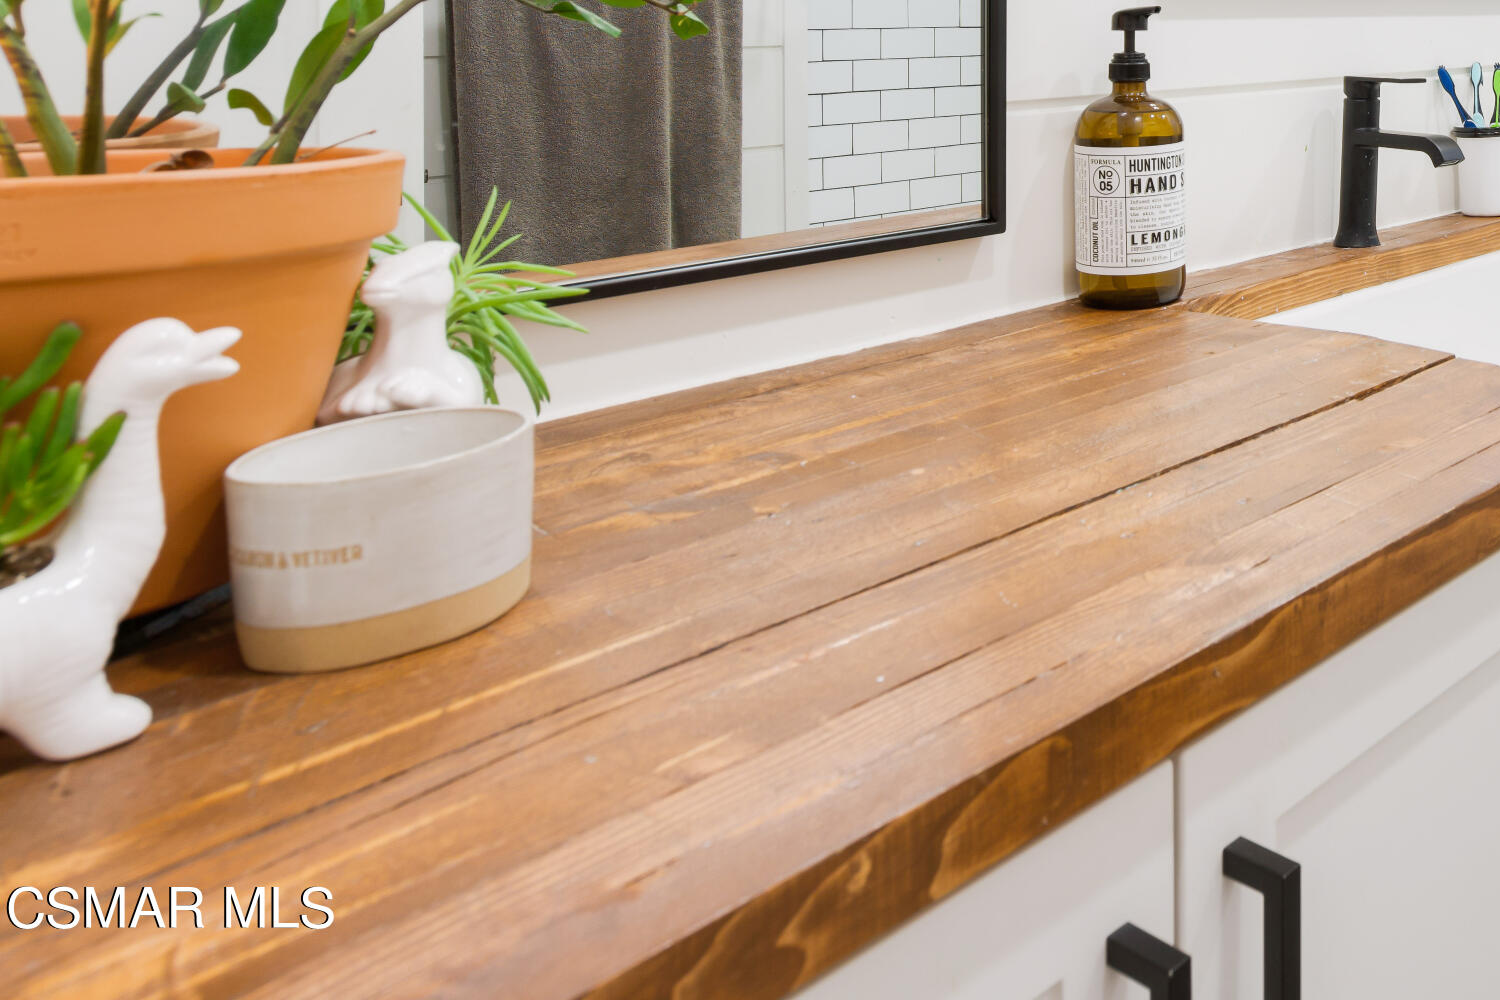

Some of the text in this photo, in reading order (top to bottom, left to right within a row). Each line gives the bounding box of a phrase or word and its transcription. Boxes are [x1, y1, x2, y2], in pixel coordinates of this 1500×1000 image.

[1090, 158, 1121, 166] FORMULA
[1129, 155, 1182, 173] HUNTINGTON
[1099, 181, 1113, 192] 05
[1130, 174, 1177, 195] HAND
